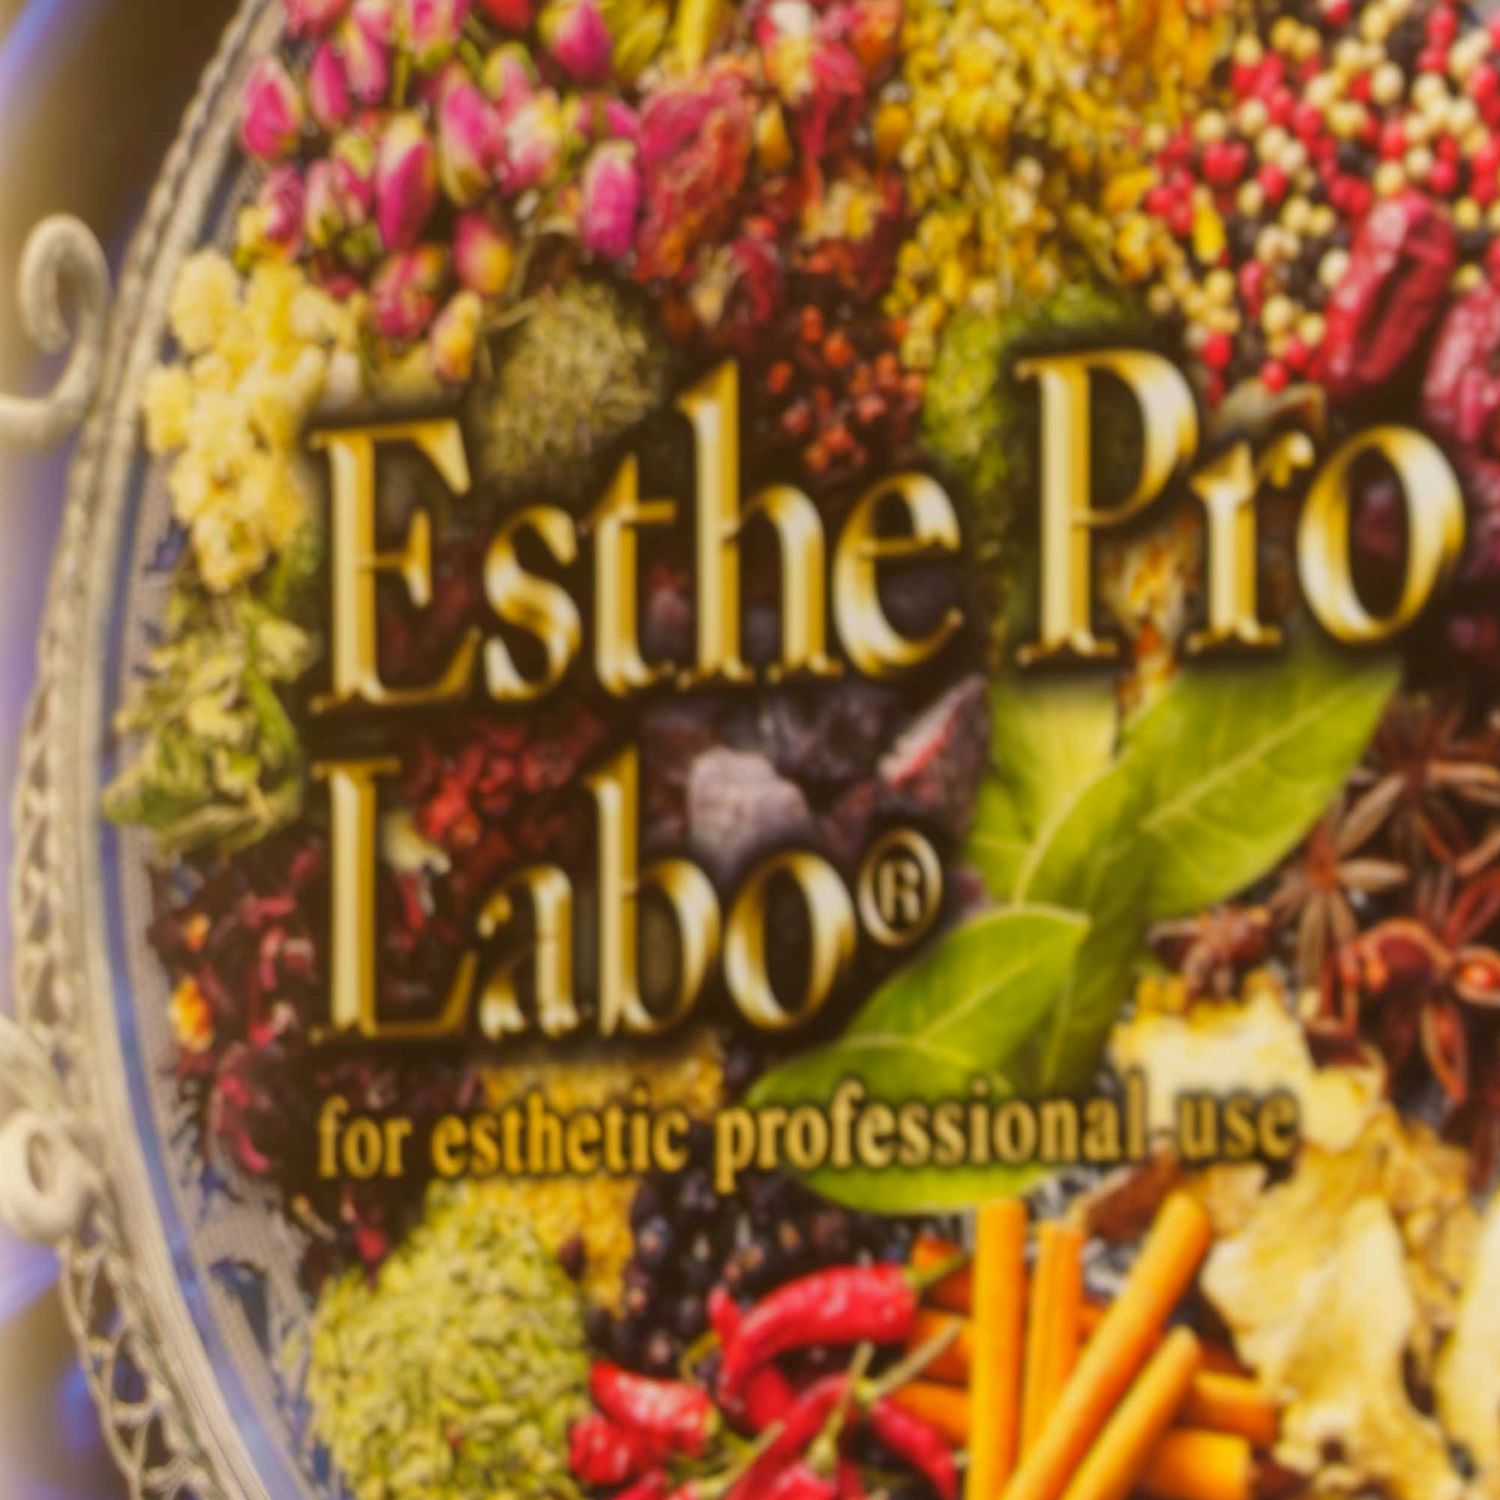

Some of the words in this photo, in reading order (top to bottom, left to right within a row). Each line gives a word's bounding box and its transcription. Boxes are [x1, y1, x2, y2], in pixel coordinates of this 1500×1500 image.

[312, 358, 962, 711] Esthe
[1016, 346, 1467, 665] Pro
[317, 1094, 412, 1178] for
[431, 1088, 690, 1178] esthetic
[714, 1070, 1146, 1195] professional
[1177, 1092, 1297, 1163] use
